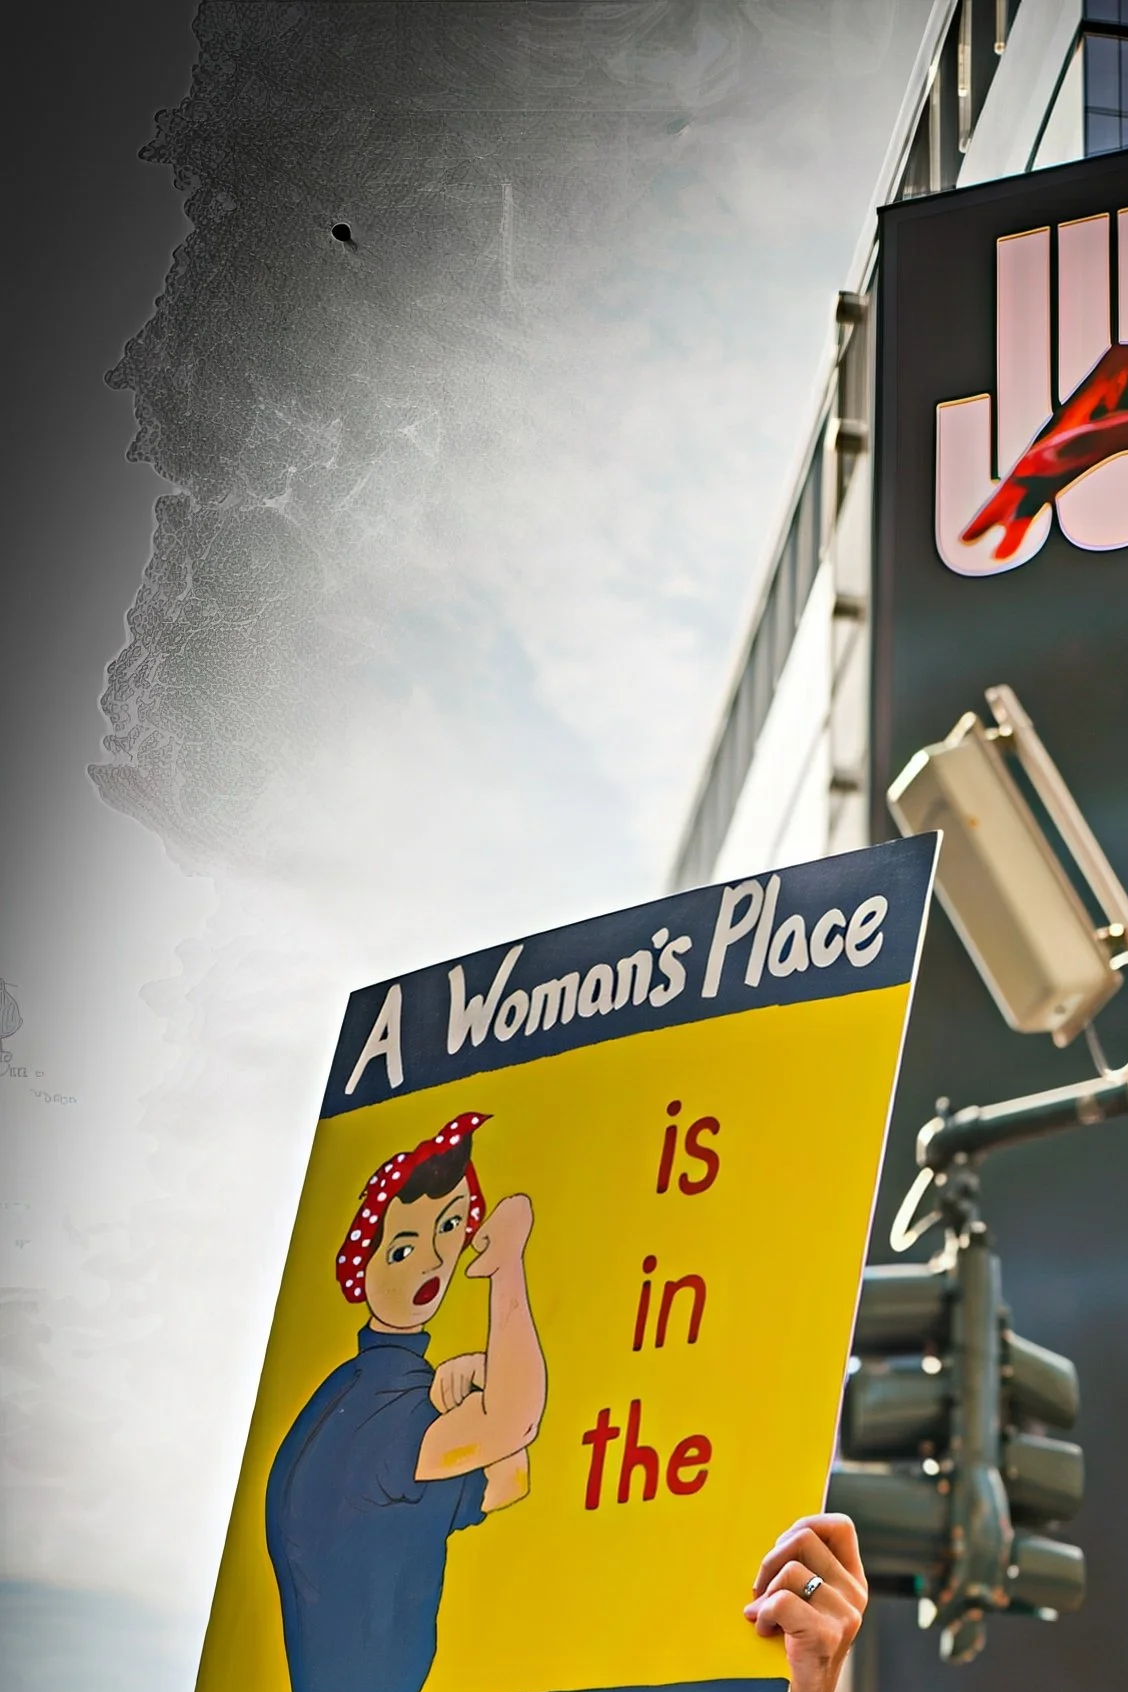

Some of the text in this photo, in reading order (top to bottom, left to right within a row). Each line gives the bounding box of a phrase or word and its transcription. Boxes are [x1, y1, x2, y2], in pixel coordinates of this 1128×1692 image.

[344, 873, 889, 1095] A Woman's Place
[655, 1100, 722, 1196] is
[631, 1255, 708, 1352] in
[581, 1398, 714, 1511] the
